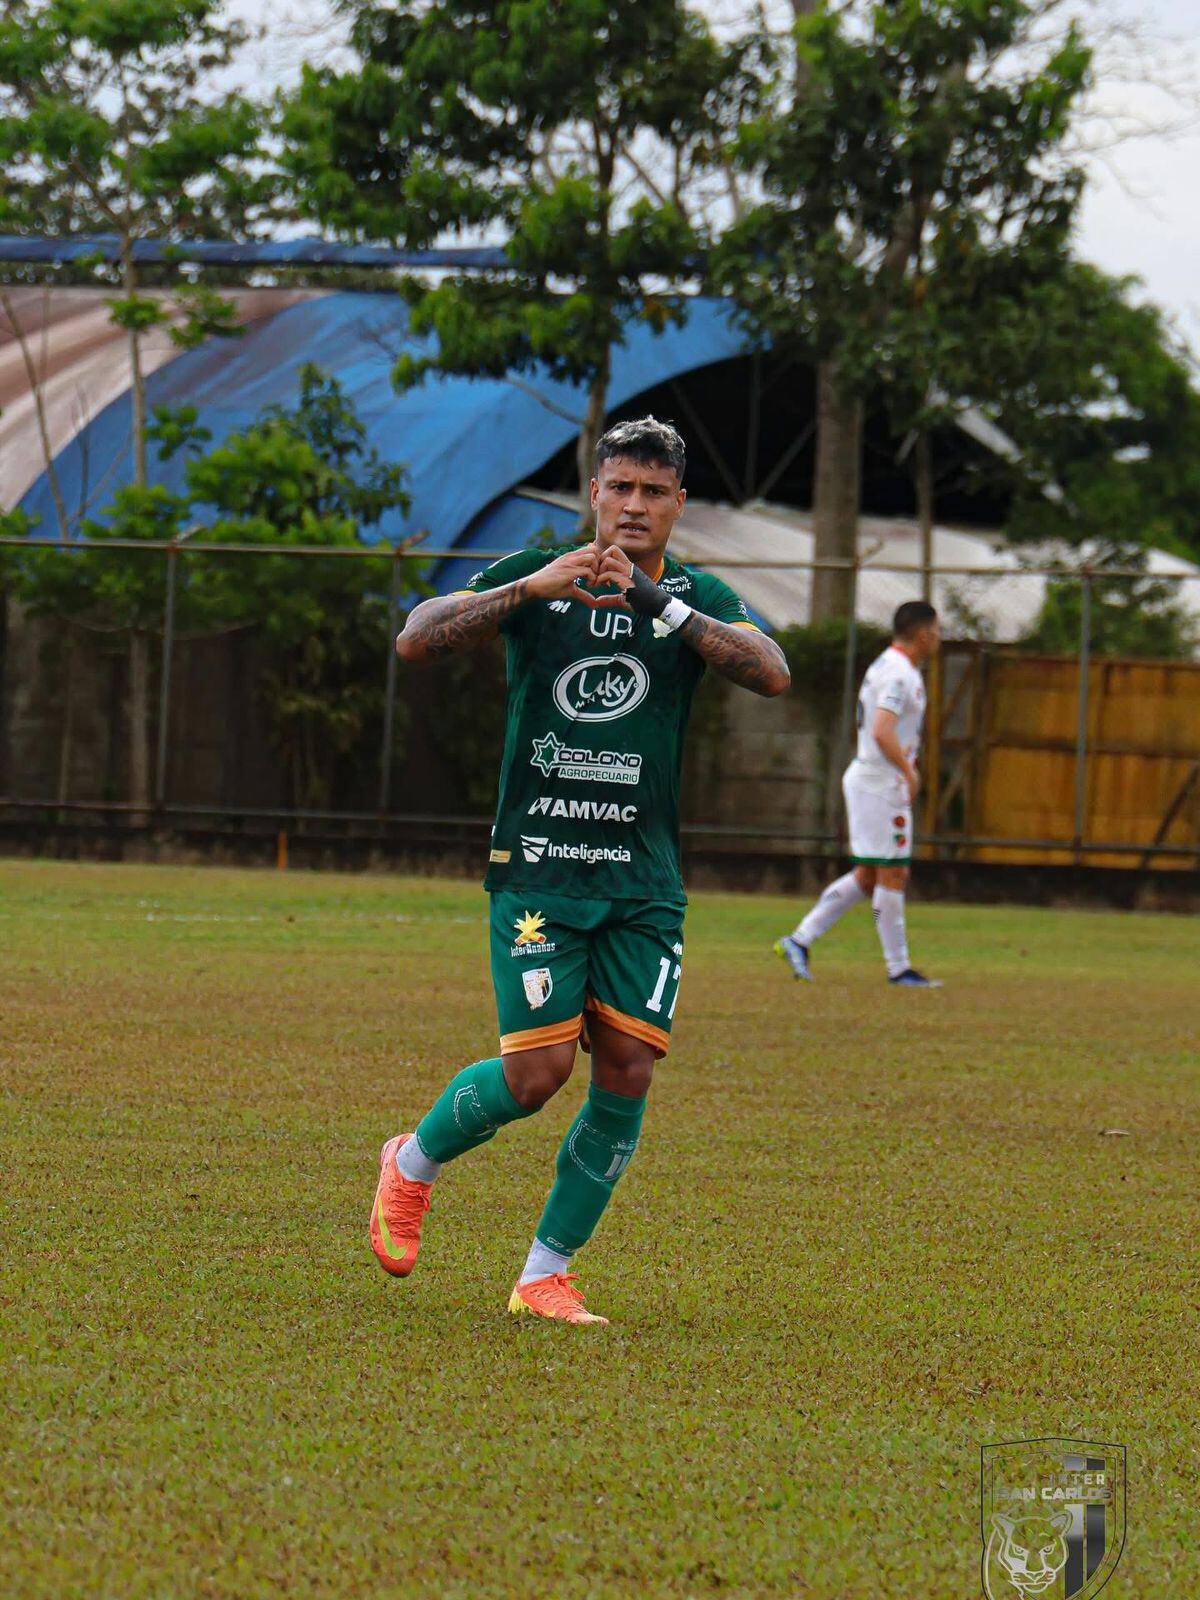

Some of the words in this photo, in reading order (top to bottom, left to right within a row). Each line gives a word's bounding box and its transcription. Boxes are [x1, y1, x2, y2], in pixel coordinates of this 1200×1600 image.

[558, 750, 641, 768] COLONO
[559, 767, 638, 783] AGROPECUARIO
[550, 799, 638, 822] AMVAC
[547, 842, 631, 864] Inteligencia
